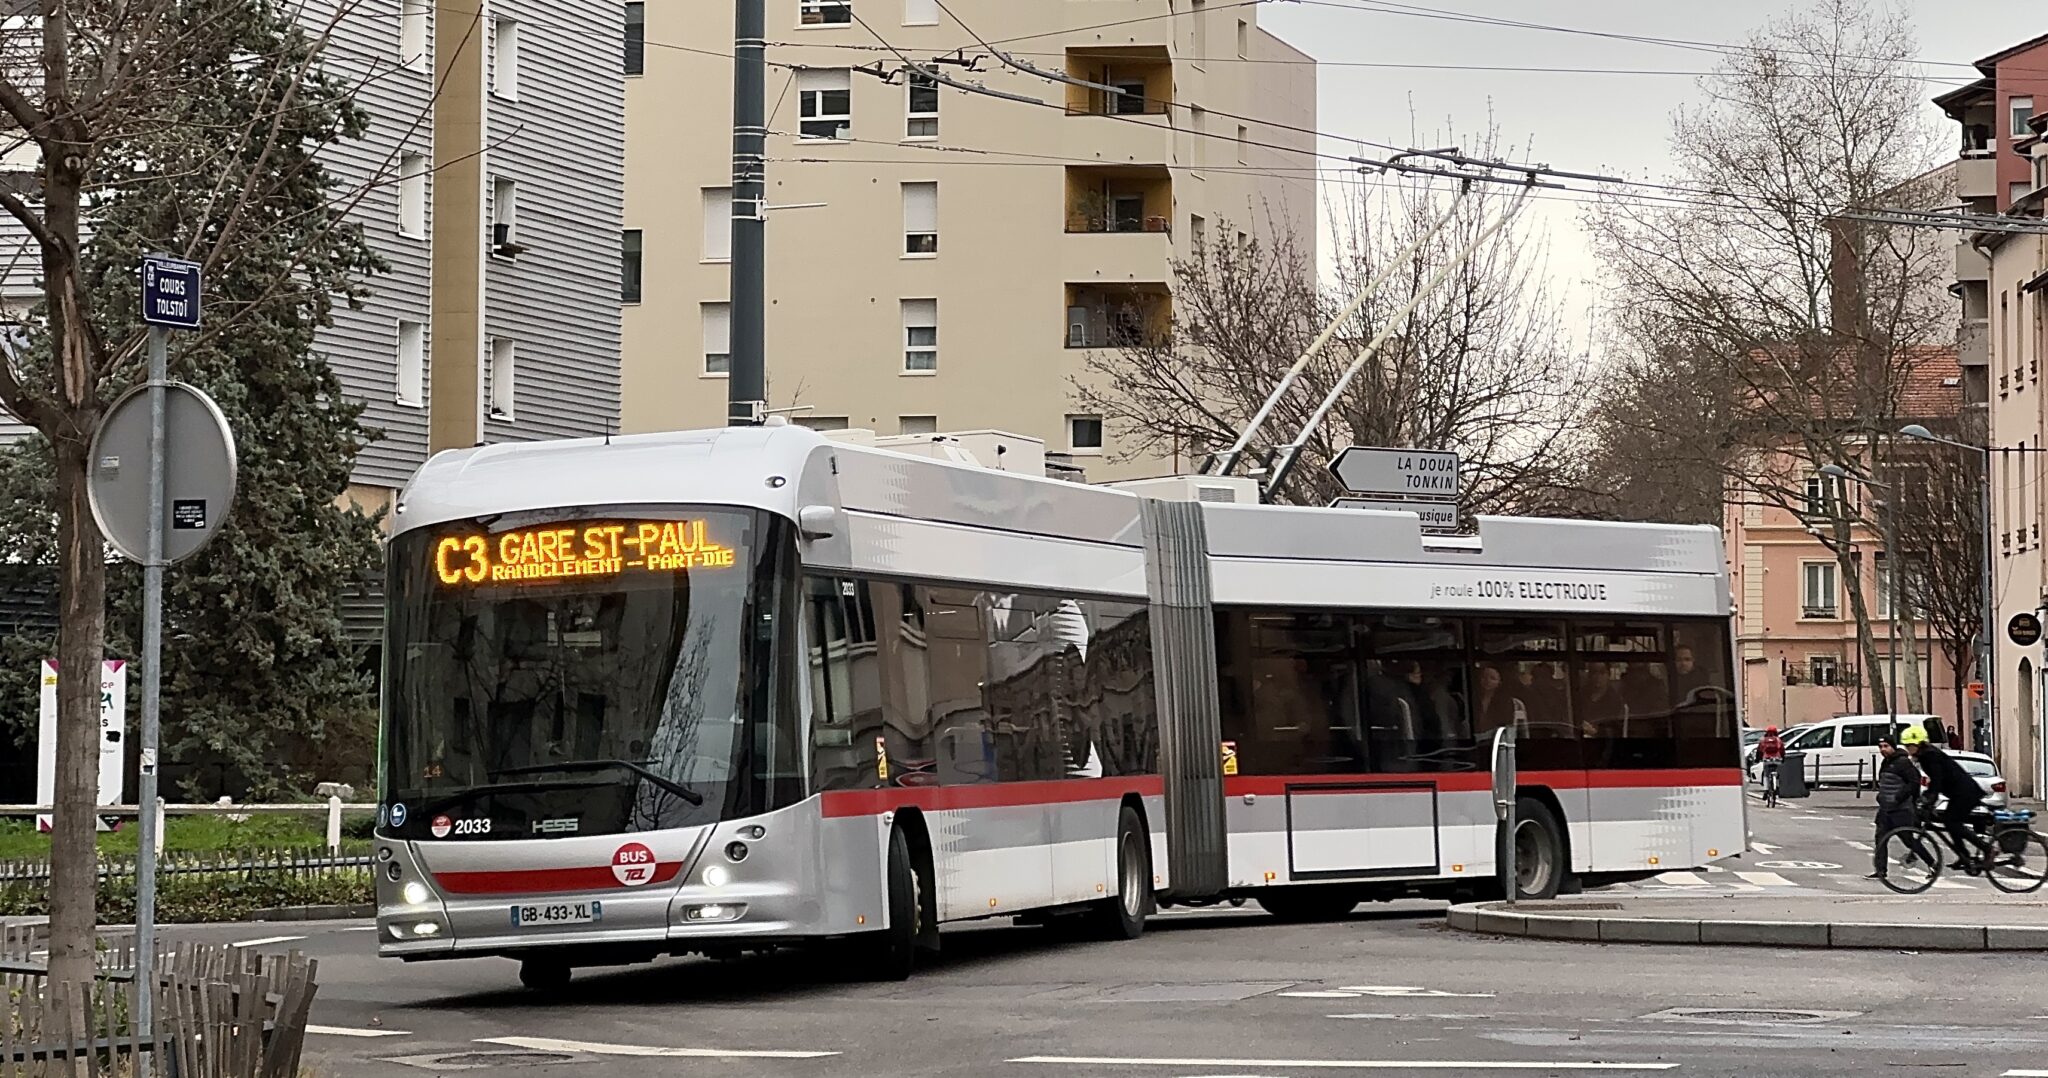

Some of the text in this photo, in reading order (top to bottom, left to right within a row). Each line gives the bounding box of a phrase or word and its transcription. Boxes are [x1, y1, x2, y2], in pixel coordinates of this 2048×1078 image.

[160, 277, 185, 295] COURS
[157, 298, 188, 317] TOLSTOÏ
[1398, 457, 1453, 472] LA DOUA
[1406, 474, 1453, 489] TONKIN
[499, 519, 720, 564] GARE ST-PAUL
[436, 535, 488, 584] C3
[647, 549, 734, 570] PART-DIE
[842, 581, 855, 596] 2033
[1430, 580, 1607, 601] je roule 100% ELECTRIQUE
[454, 818, 491, 835] 2033
[532, 818, 578, 834] HESS
[619, 850, 648, 864] BUS
[521, 904, 591, 922] GB-433-XL
